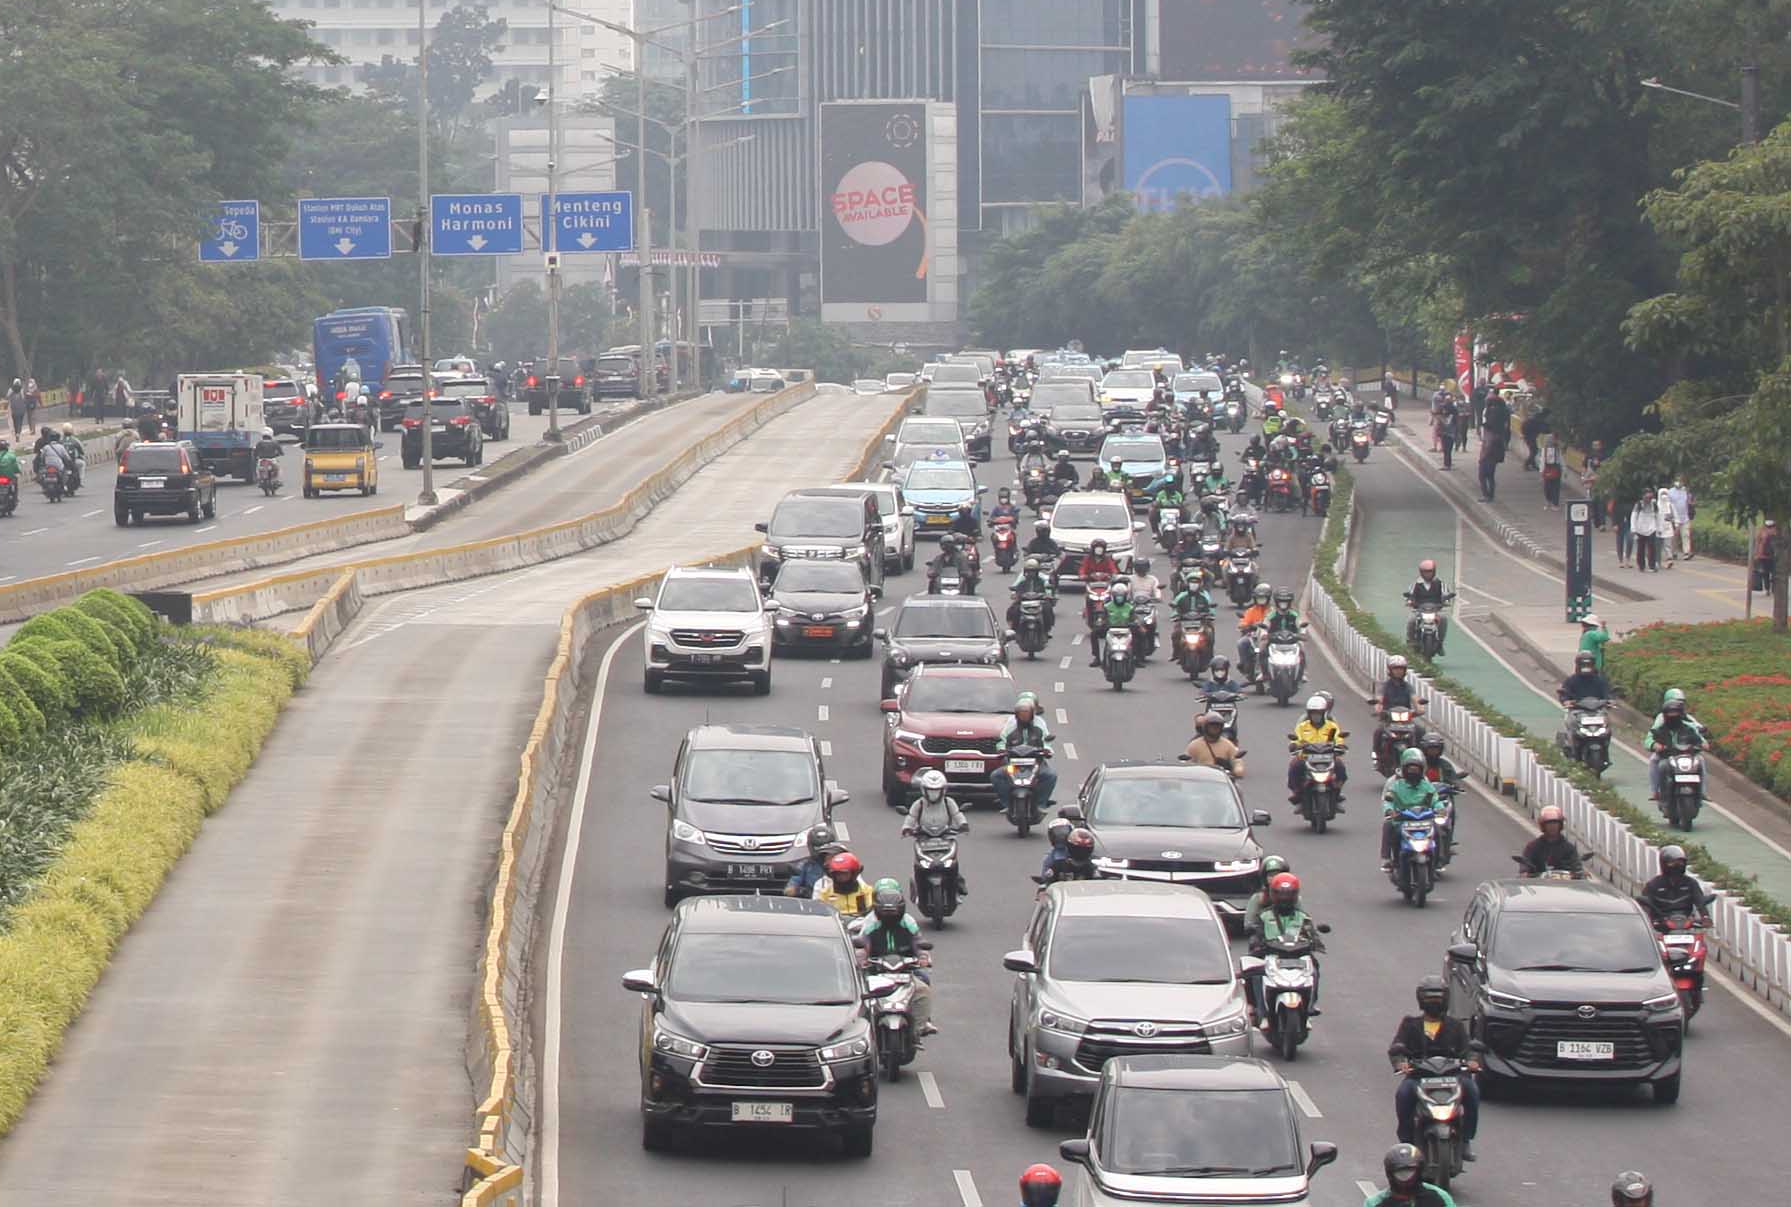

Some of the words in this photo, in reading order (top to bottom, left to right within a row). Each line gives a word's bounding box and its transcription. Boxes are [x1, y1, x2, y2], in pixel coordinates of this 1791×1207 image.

[831, 183, 917, 214] SPACE
[449, 202, 503, 215] Monas
[841, 205, 909, 224] AVAILABLE
[441, 217, 512, 232] Harmoni
[563, 216, 610, 229] Cikini
